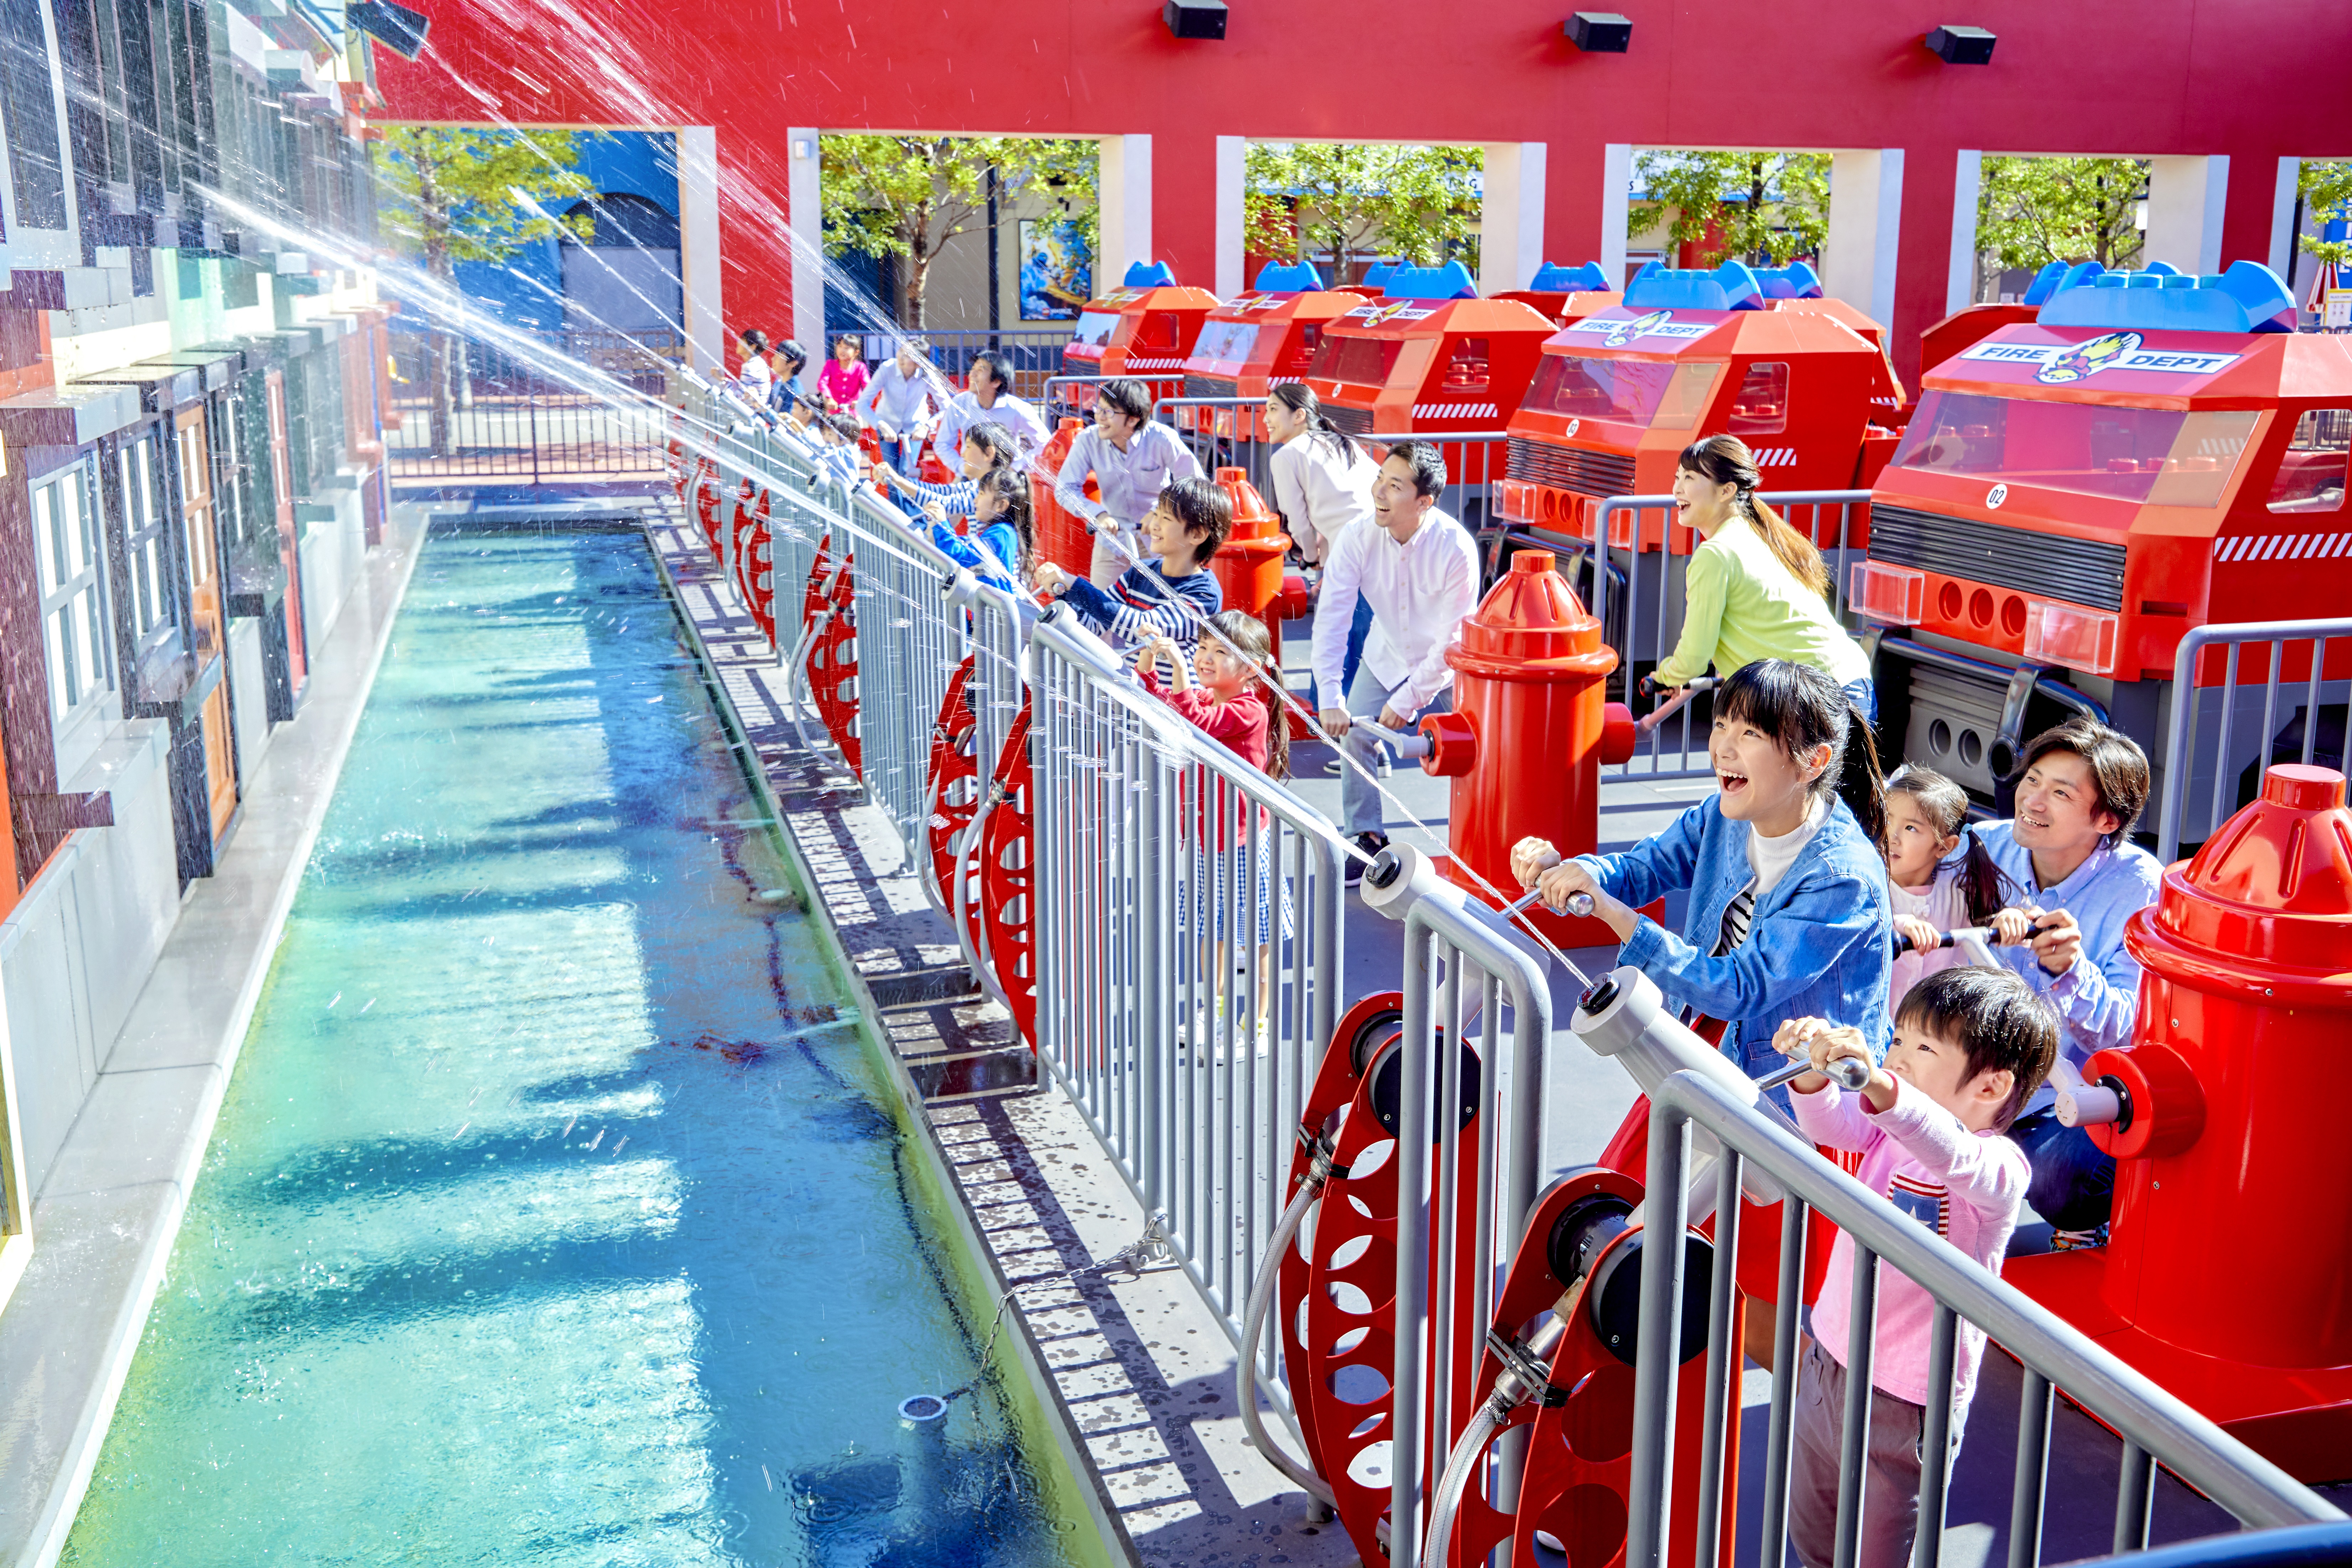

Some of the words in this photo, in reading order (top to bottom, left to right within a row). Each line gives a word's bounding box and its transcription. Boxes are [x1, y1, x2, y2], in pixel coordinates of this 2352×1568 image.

[1655, 326, 1705, 335] DEPT
[1980, 348, 2051, 359] FIRE
[2126, 355, 2222, 369] DEPT
[1989, 489, 2004, 503] 02
